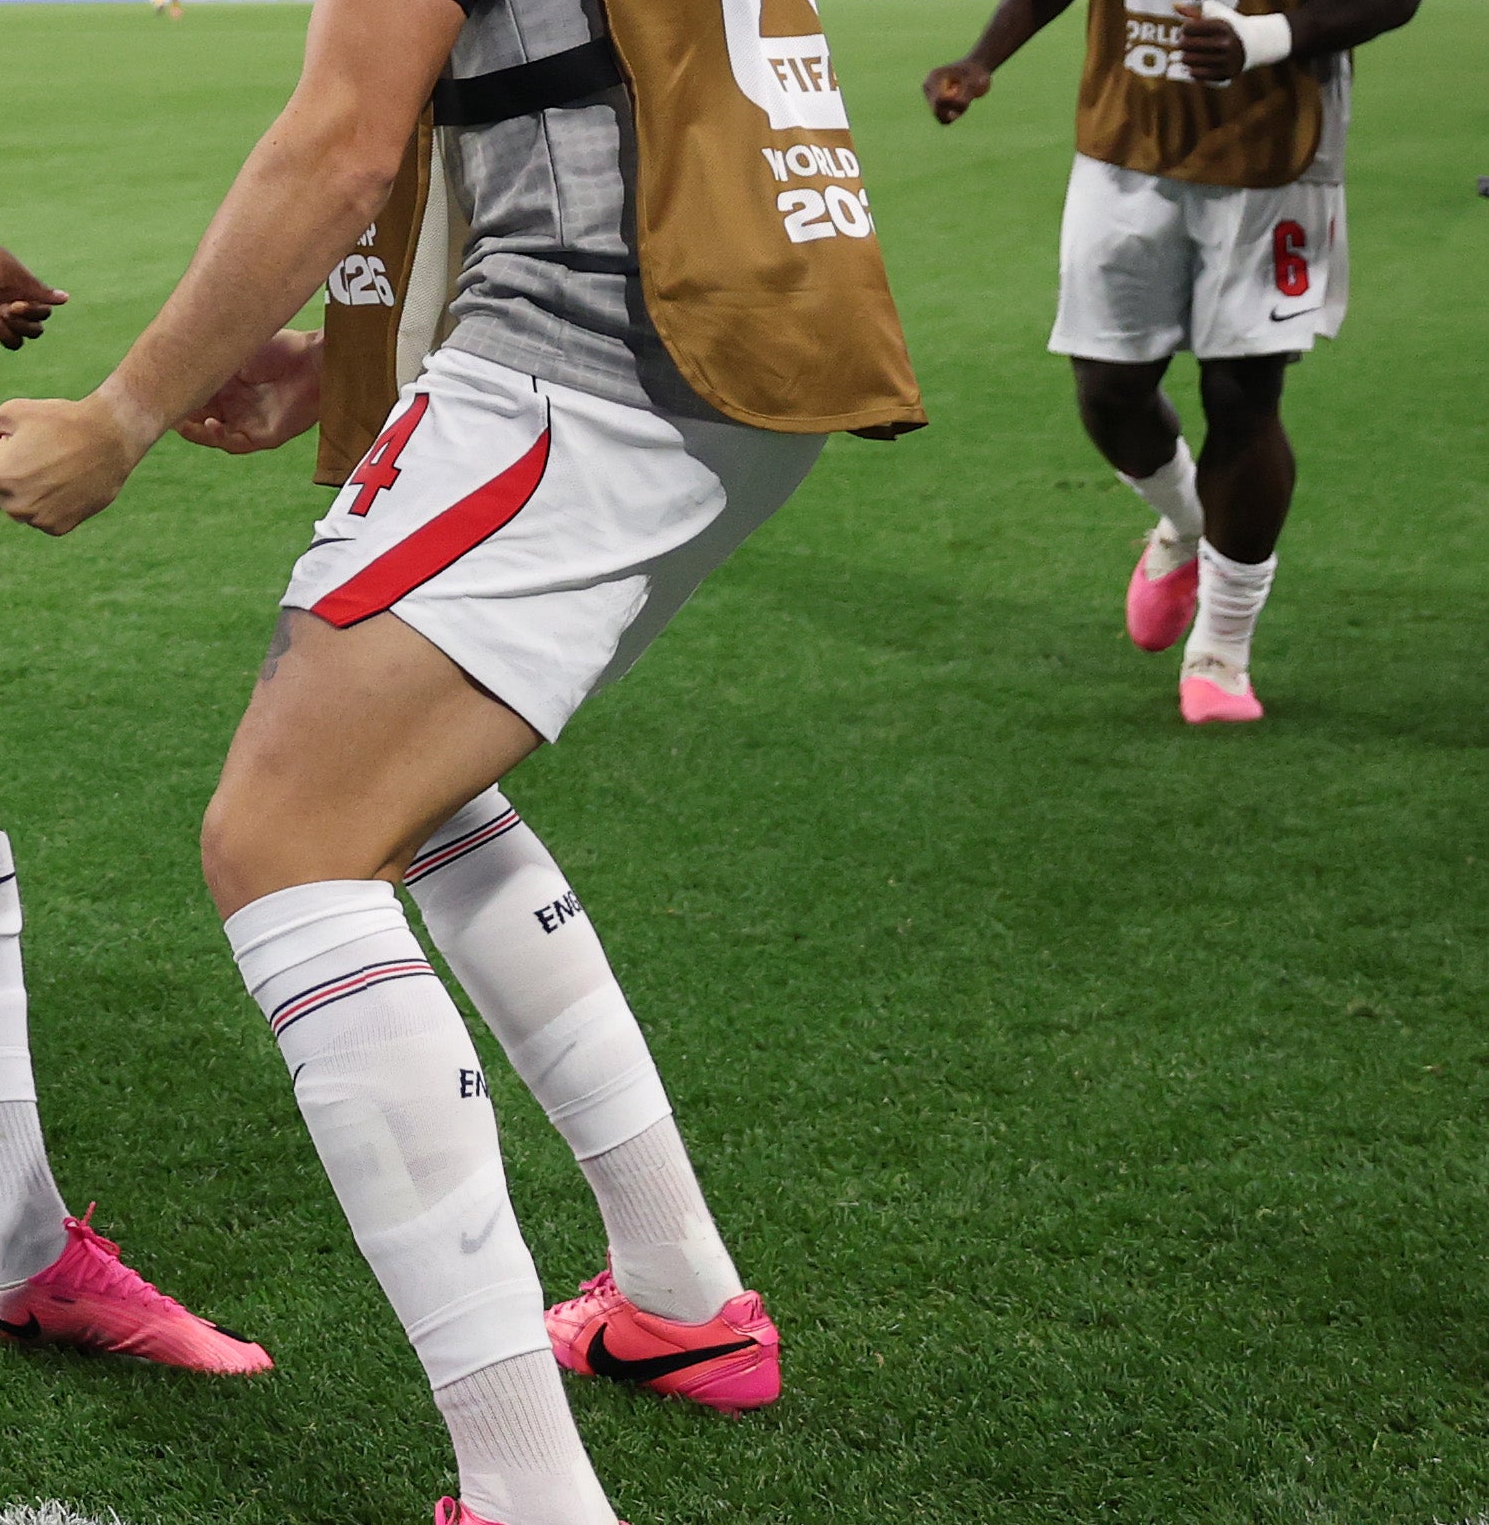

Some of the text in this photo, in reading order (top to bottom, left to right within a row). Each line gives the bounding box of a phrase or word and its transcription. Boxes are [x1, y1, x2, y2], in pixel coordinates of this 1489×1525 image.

[761, 144, 860, 182] WORLD
[325, 254, 395, 307] 026
[1273, 219, 1310, 296] 6
[348, 392, 430, 518] 4
